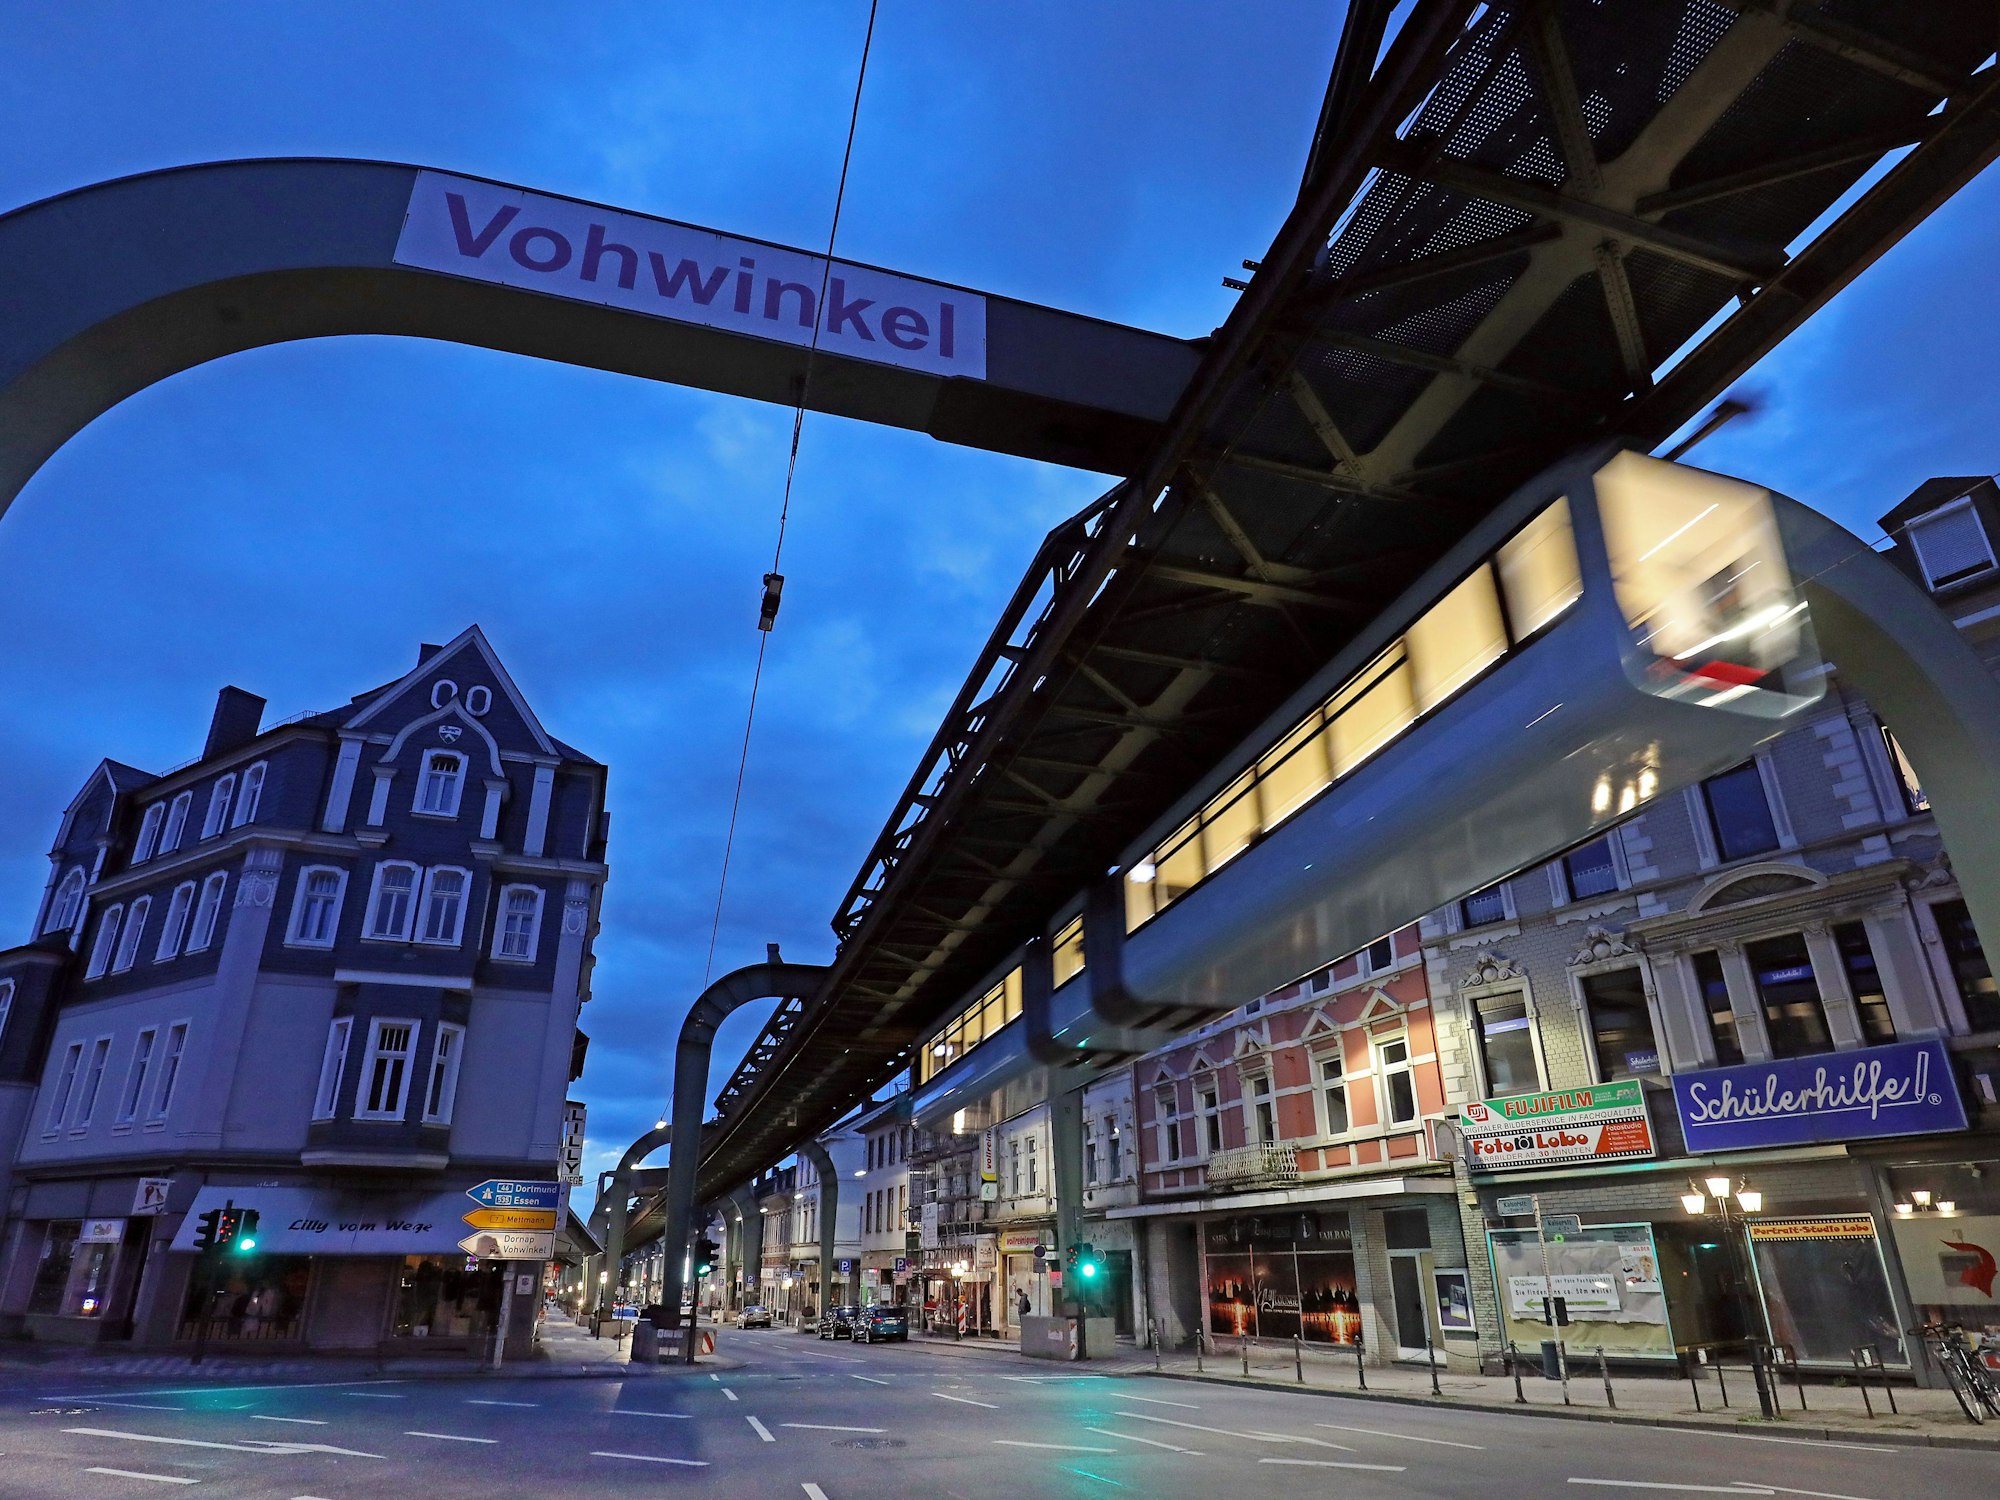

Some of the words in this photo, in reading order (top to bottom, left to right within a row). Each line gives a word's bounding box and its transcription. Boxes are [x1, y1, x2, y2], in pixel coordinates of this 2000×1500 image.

[444, 191, 955, 359] Vohwinkel
[1504, 1091, 1594, 1118] FUJIFILM
[1464, 1124, 1503, 1134] DIGITALER
[1504, 1116, 1566, 1131] BILDERSERVICE
[1568, 1114, 1577, 1122] IN
[1579, 1106, 1643, 1122] FACHQUALITÄT
[1605, 1122, 1642, 1132] Fotostudio
[565, 1109, 584, 1174] LILLY
[1473, 1138, 1514, 1155] Foto
[1536, 1131, 1589, 1149] Lobo
[1525, 1151, 1536, 1159] AB
[1552, 1146, 1592, 1157] MINUTEN
[515, 1184, 558, 1194] Dortmund
[497, 1196, 511, 1204] 535
[513, 1196, 540, 1205] Essen
[288, 1219, 329, 1233] Lilly
[338, 1223, 376, 1232] vom
[506, 1216, 545, 1224] Mettmann
[504, 1235, 535, 1244] Dornap
[503, 1245, 547, 1254] Vohwinkel
